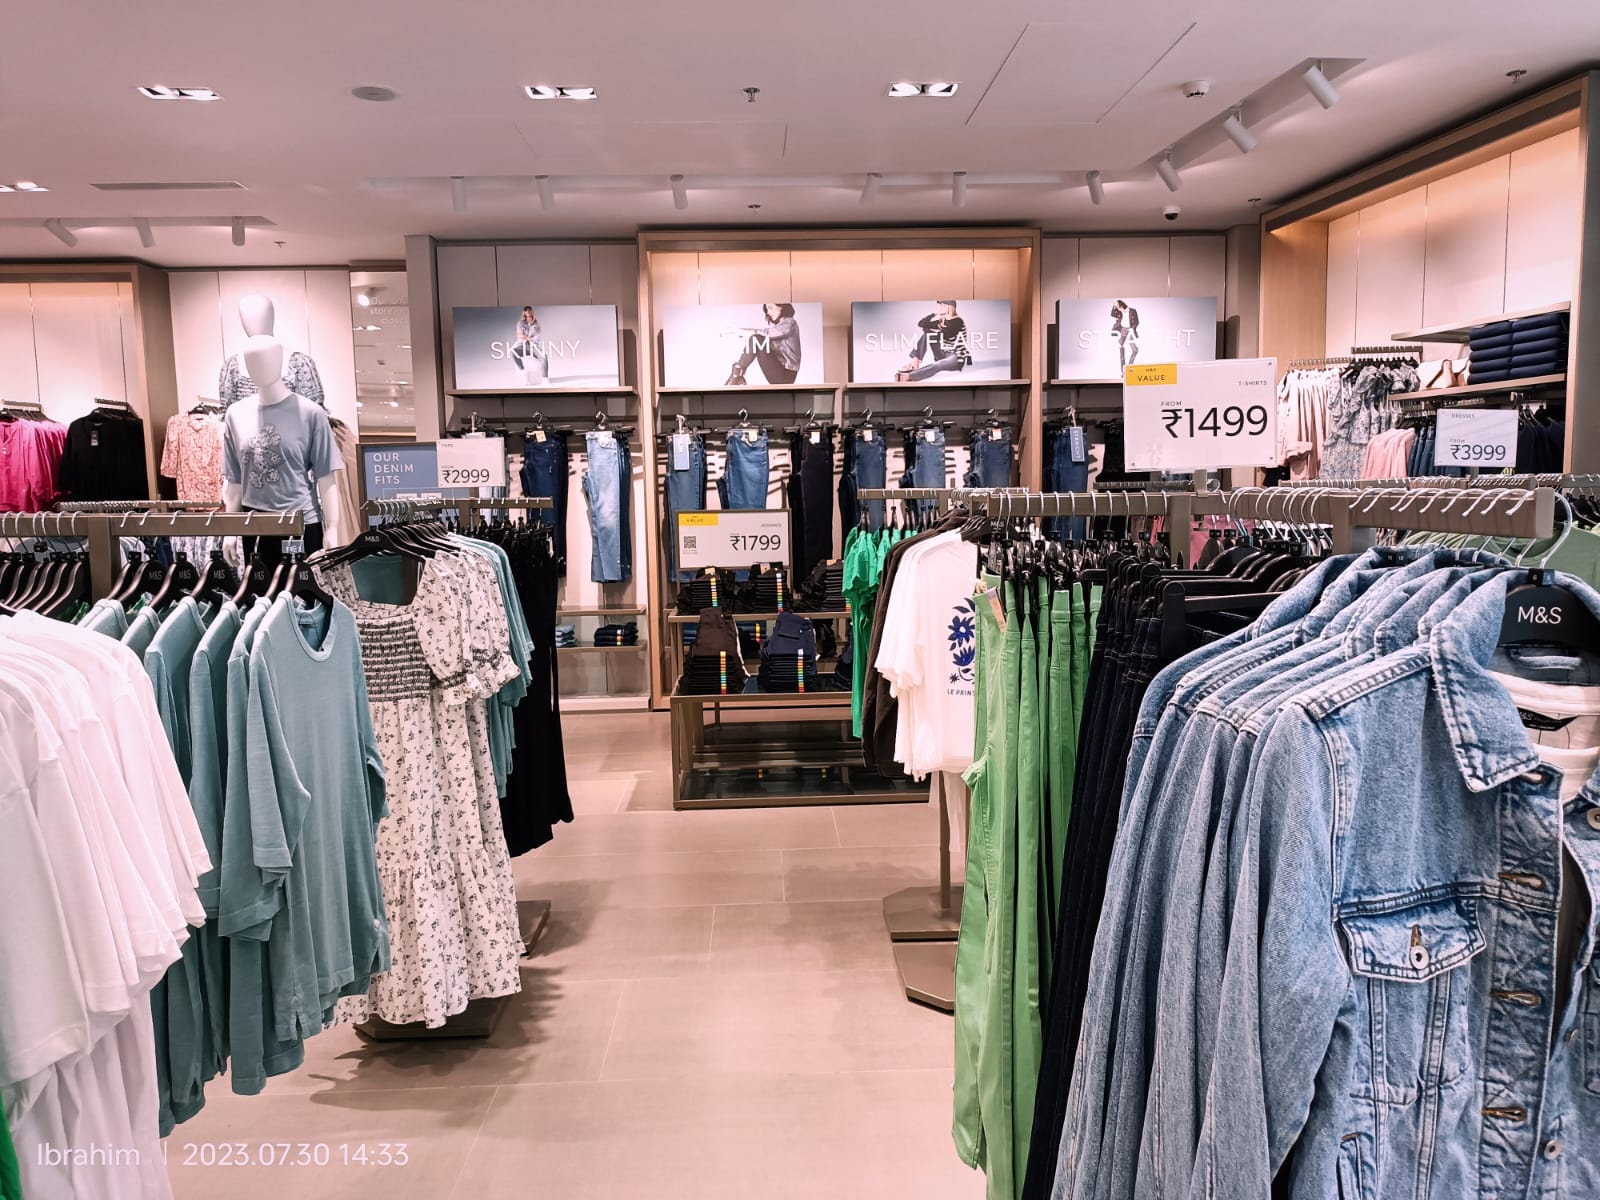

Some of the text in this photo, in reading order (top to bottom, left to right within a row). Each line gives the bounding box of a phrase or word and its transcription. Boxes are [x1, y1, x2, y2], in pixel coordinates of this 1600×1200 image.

[865, 331, 999, 351] SLIM FLARE
[490, 341, 580, 360] SKINNY
[1161, 405, 1268, 438] ₹1499
[373, 452, 400, 462] OUR
[1450, 444, 1506, 460] ₹3999
[374, 463, 414, 473] DENIM
[442, 469, 490, 483] ₹2999
[375, 475, 400, 485] FITS
[730, 534, 781, 551] ₹1799
[1517, 605, 1562, 625] M&S
